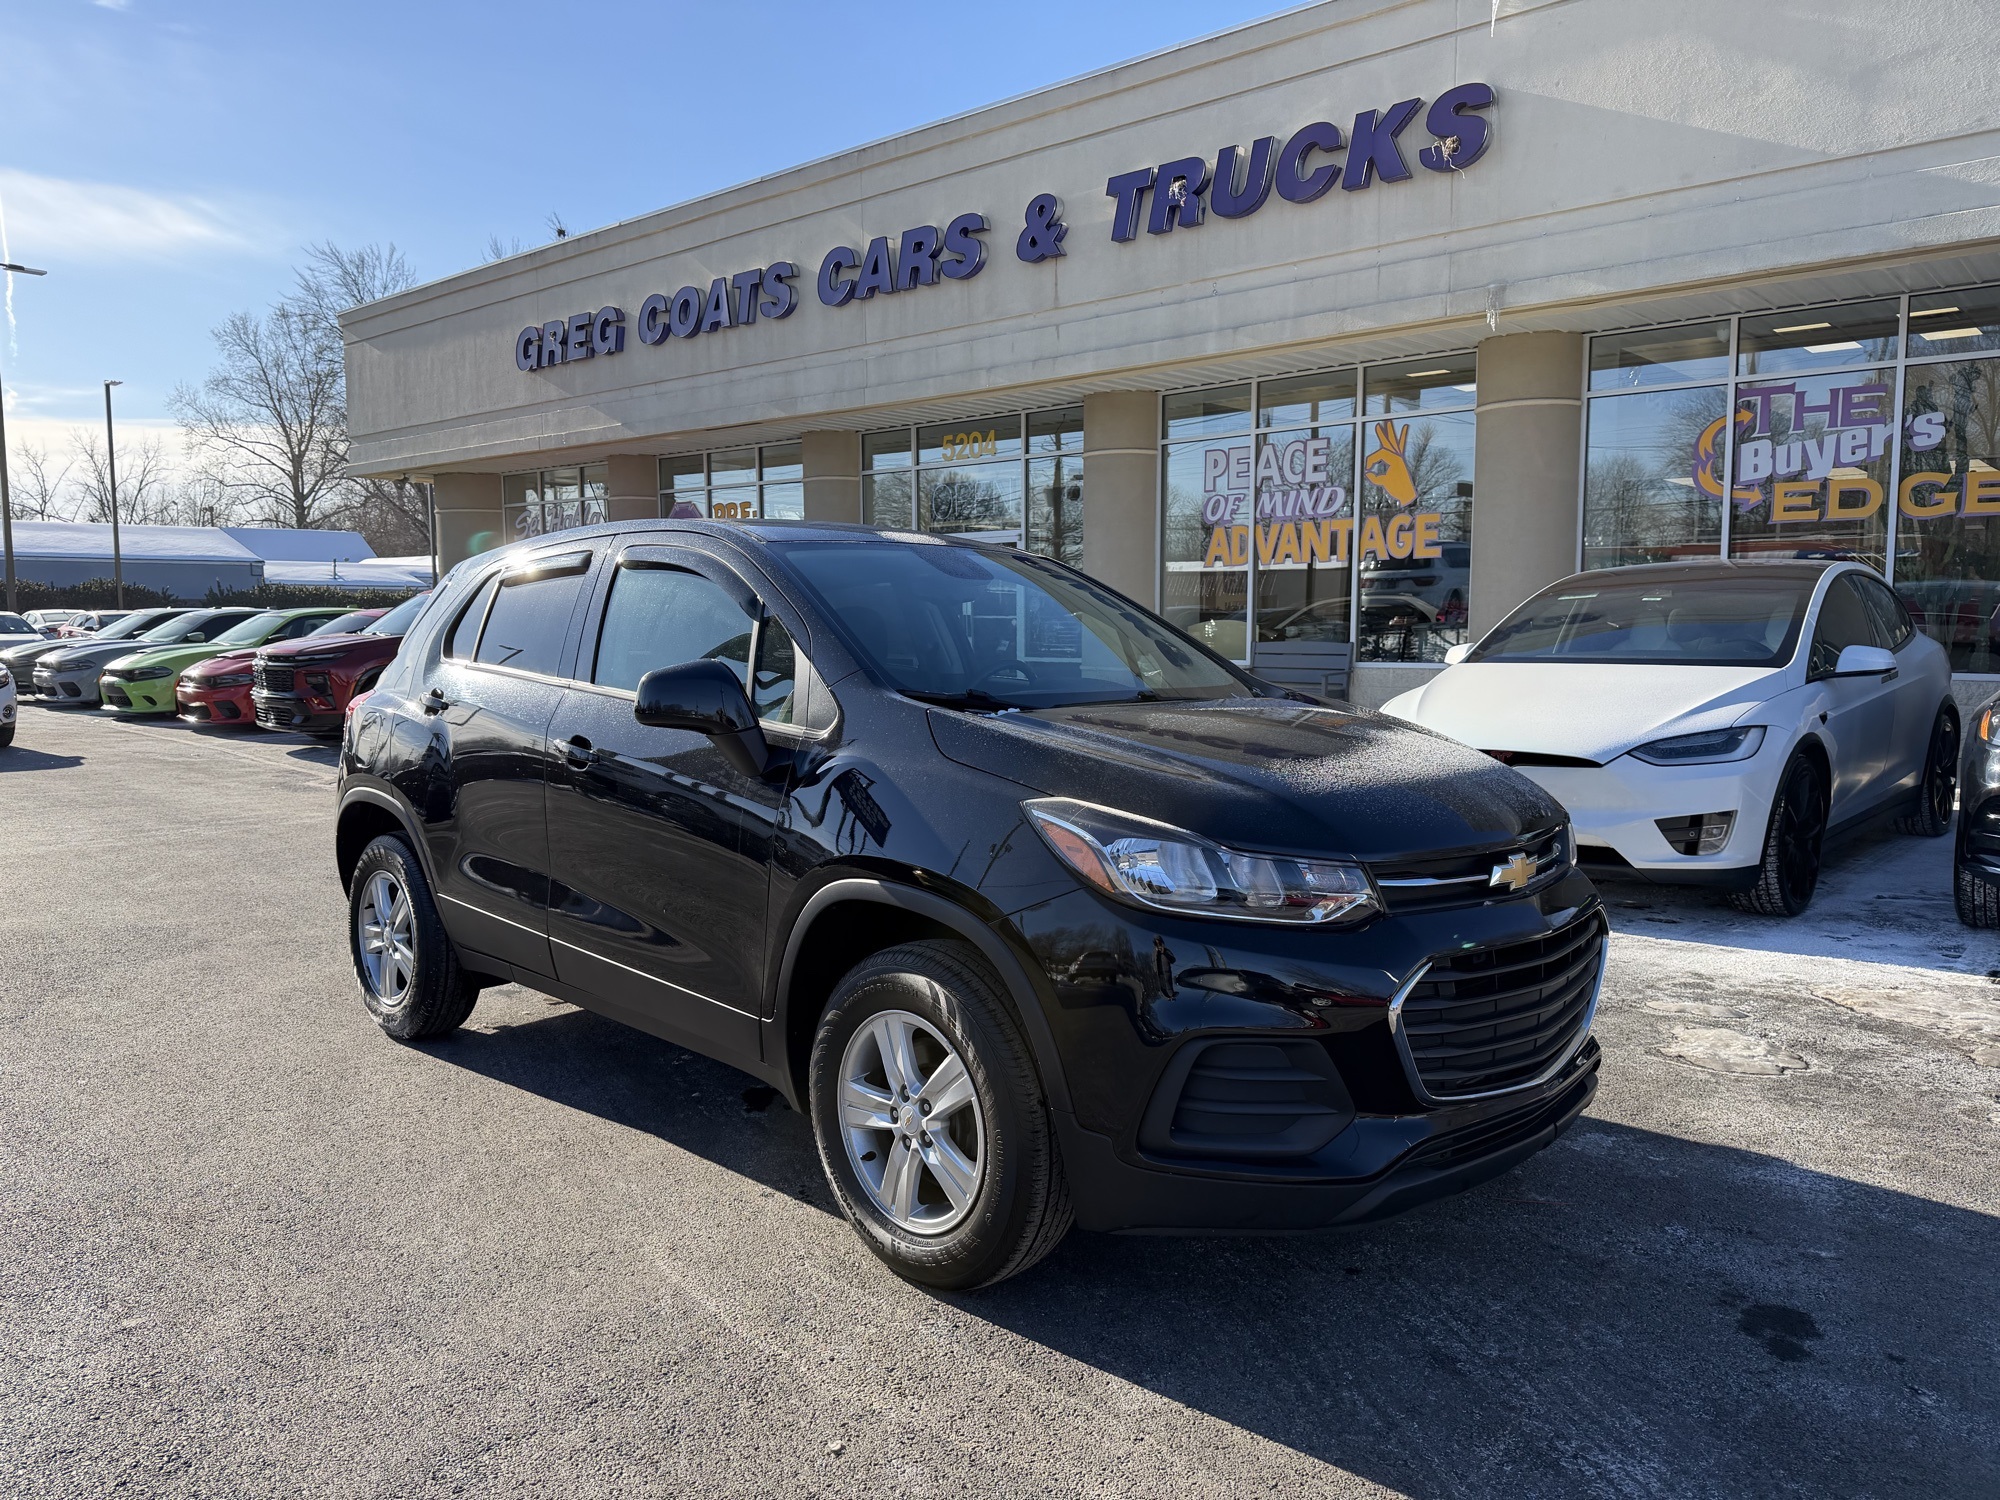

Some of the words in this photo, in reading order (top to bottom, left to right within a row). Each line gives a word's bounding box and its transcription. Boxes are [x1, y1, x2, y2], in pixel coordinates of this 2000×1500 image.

[516, 305, 625, 371] GREG
[638, 261, 800, 346] COATS
[817, 213, 991, 307] CARS
[1016, 194, 1068, 263] &
[1106, 82, 1496, 243] TRUCKS
[1737, 382, 1889, 437] THE
[941, 429, 998, 461] 5204
[1203, 437, 1330, 493] PEACE
[1737, 411, 1947, 482] Buyer's
[1203, 492, 1245, 525] OF
[1255, 486, 1345, 521] MIND
[1767, 471, 2000, 524] EDGE
[1203, 512, 1443, 568] ADVANTAGE
